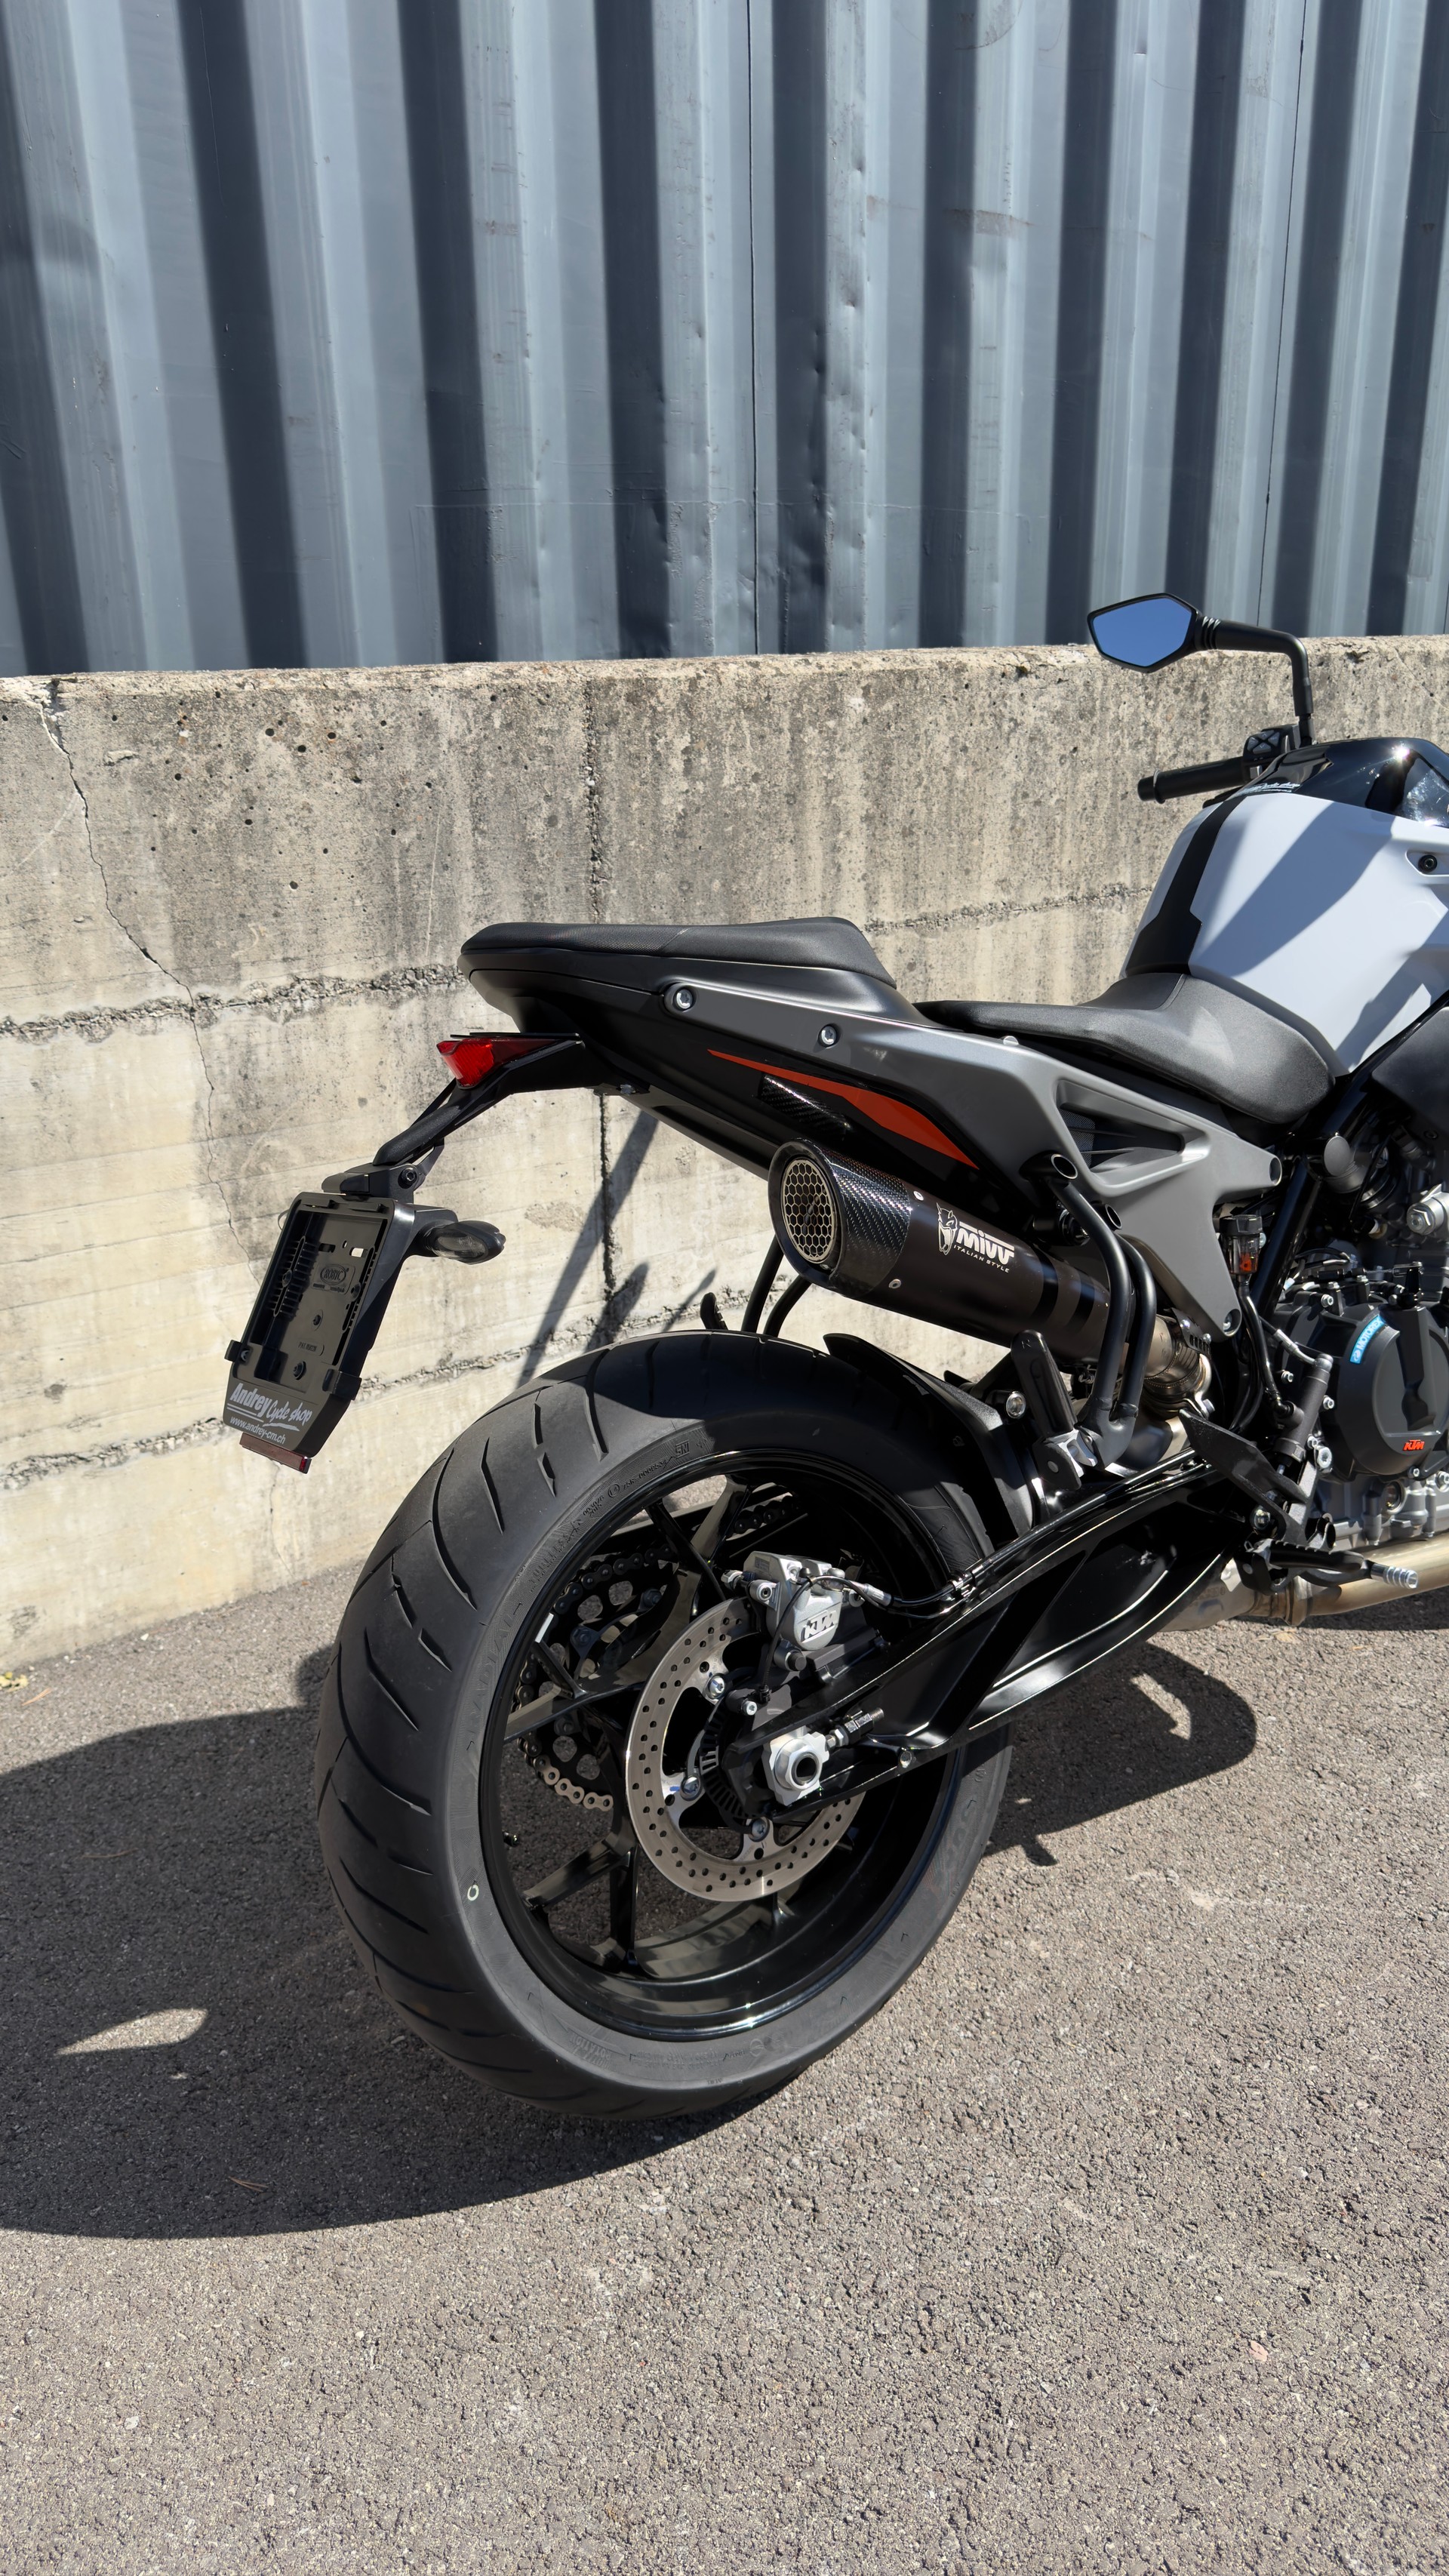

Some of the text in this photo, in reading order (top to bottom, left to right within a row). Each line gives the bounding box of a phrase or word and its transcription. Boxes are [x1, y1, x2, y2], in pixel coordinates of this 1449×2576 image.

[953, 1245, 1011, 1273] ITALIAN STYLE
[1355, 1317, 1384, 1351] MOTOREX
[229, 1383, 313, 1427] Andrey Cycle shop
[229, 1416, 287, 1445] www.andrey-cm.ch
[1403, 1439, 1425, 1451] KTM
[801, 1609, 838, 1643] KTM
